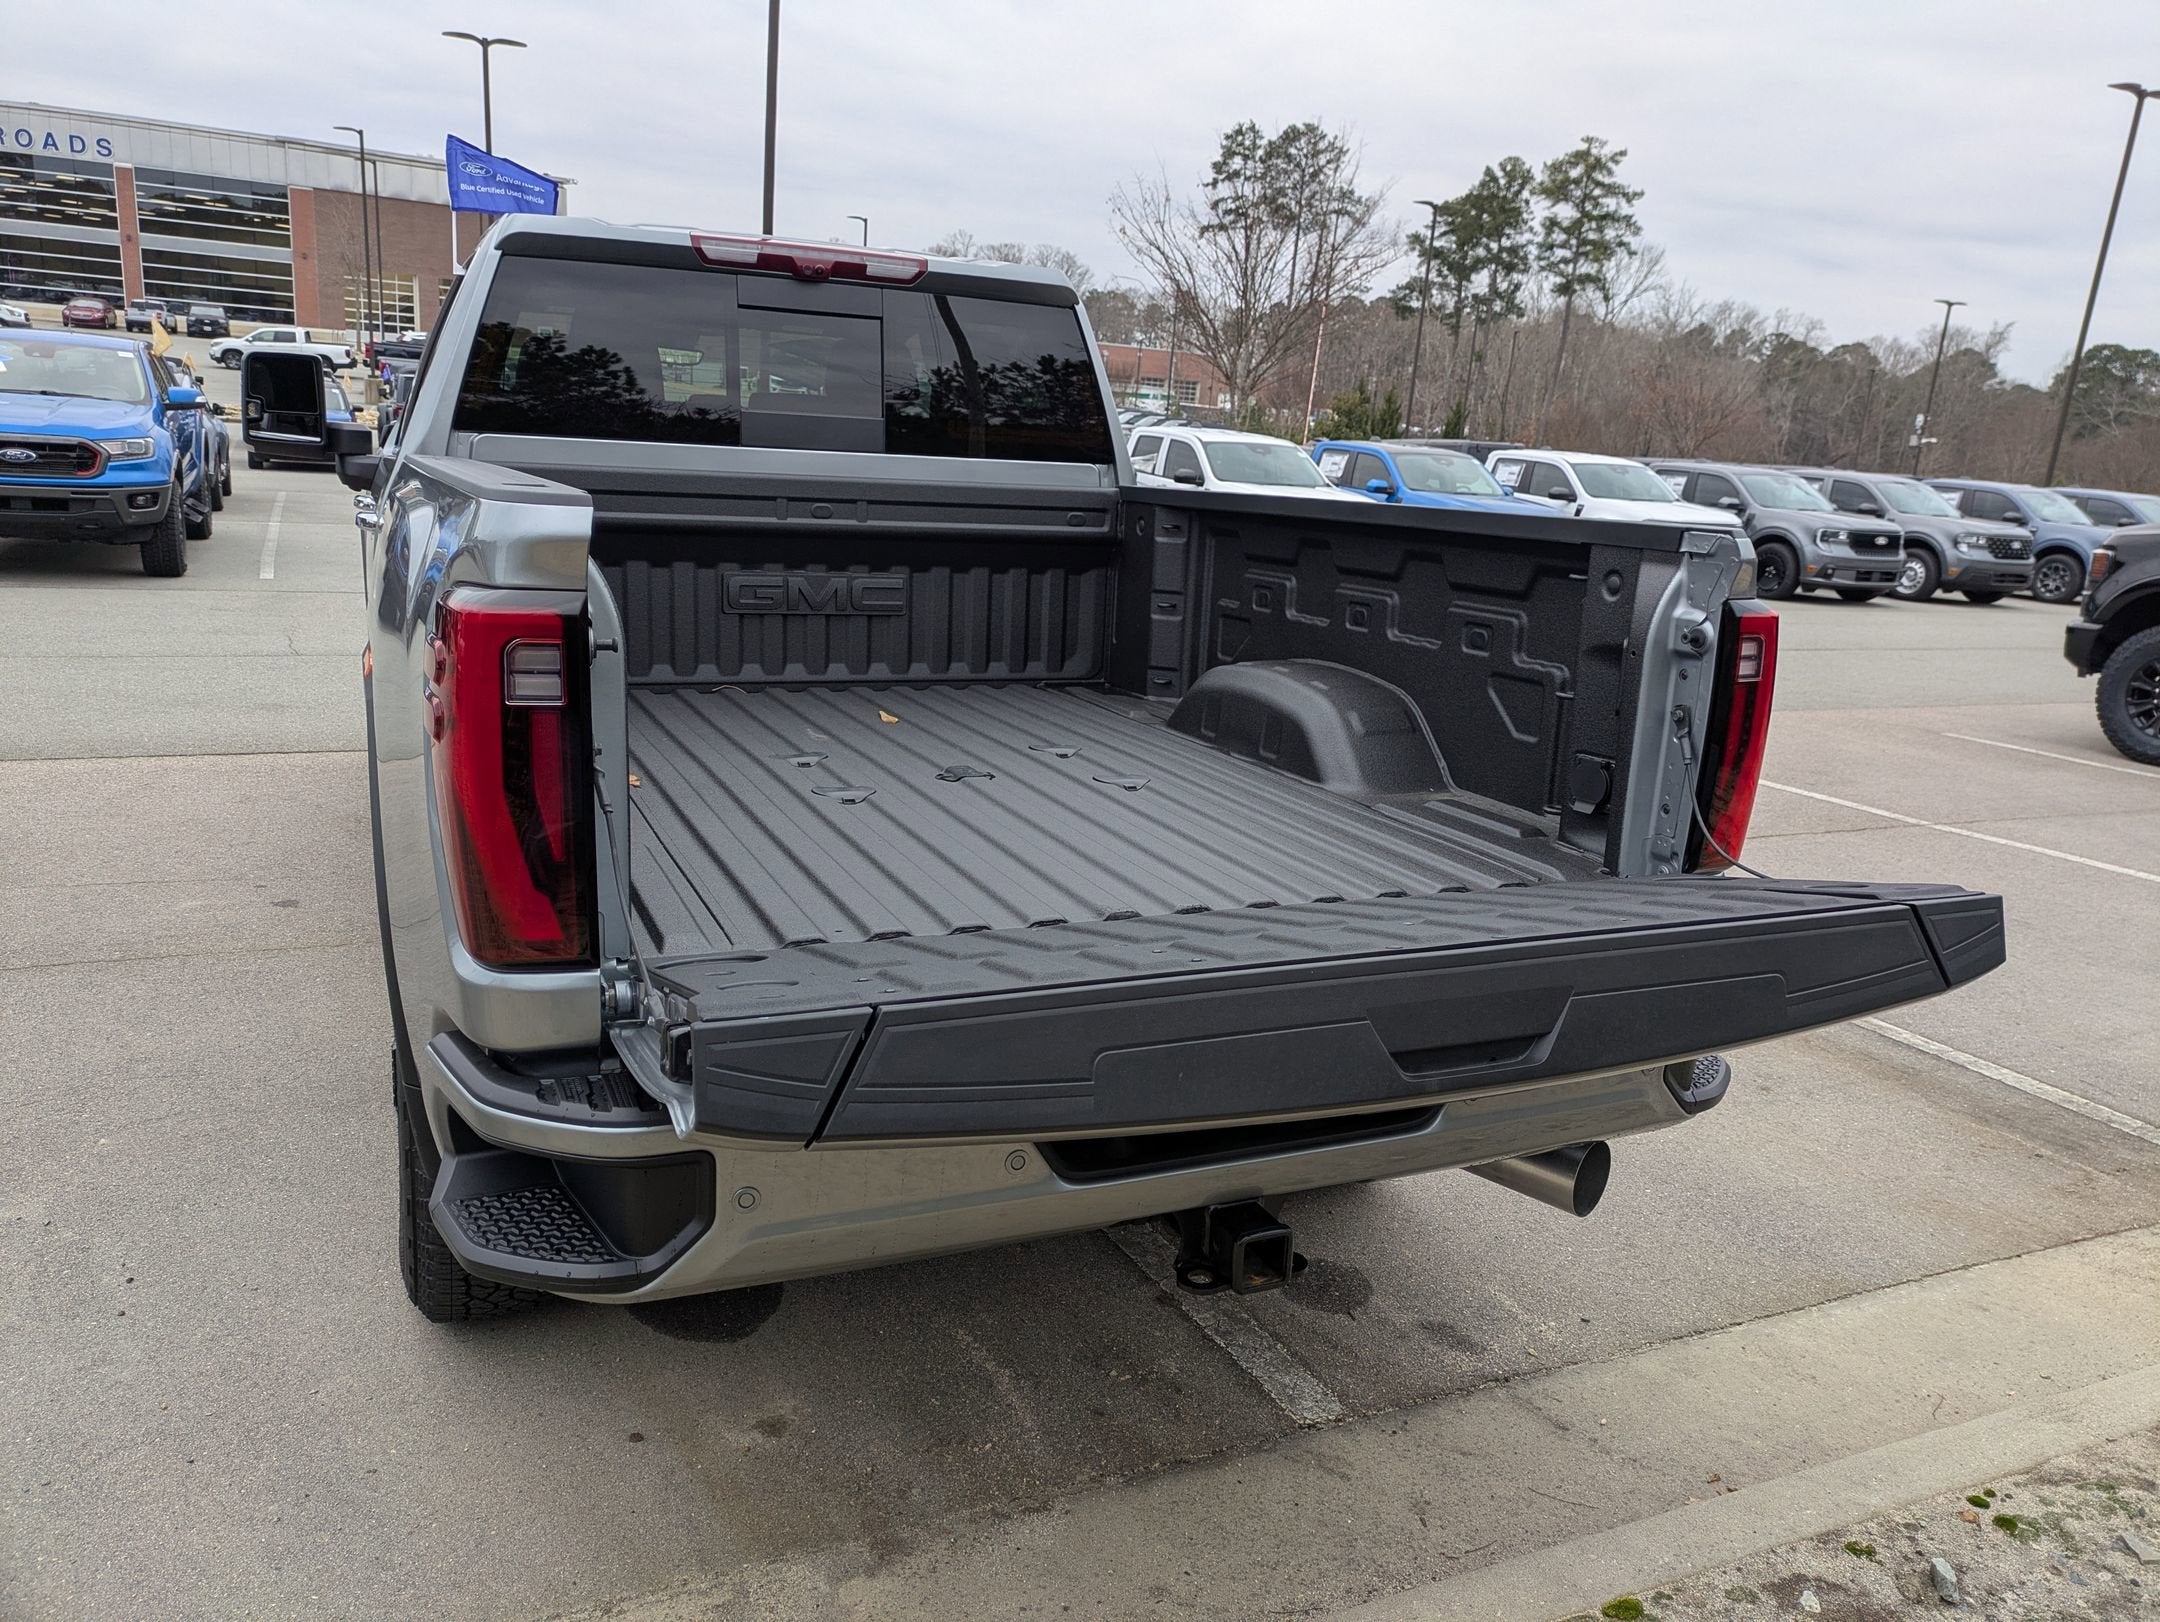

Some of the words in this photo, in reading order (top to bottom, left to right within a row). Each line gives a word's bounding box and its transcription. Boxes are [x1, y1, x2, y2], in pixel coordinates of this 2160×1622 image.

[466, 163, 487, 175] Ford
[460, 183, 476, 191] Blue
[476, 185, 505, 195] Certified
[506, 189, 522, 199] Used
[727, 576, 904, 612] GMC
